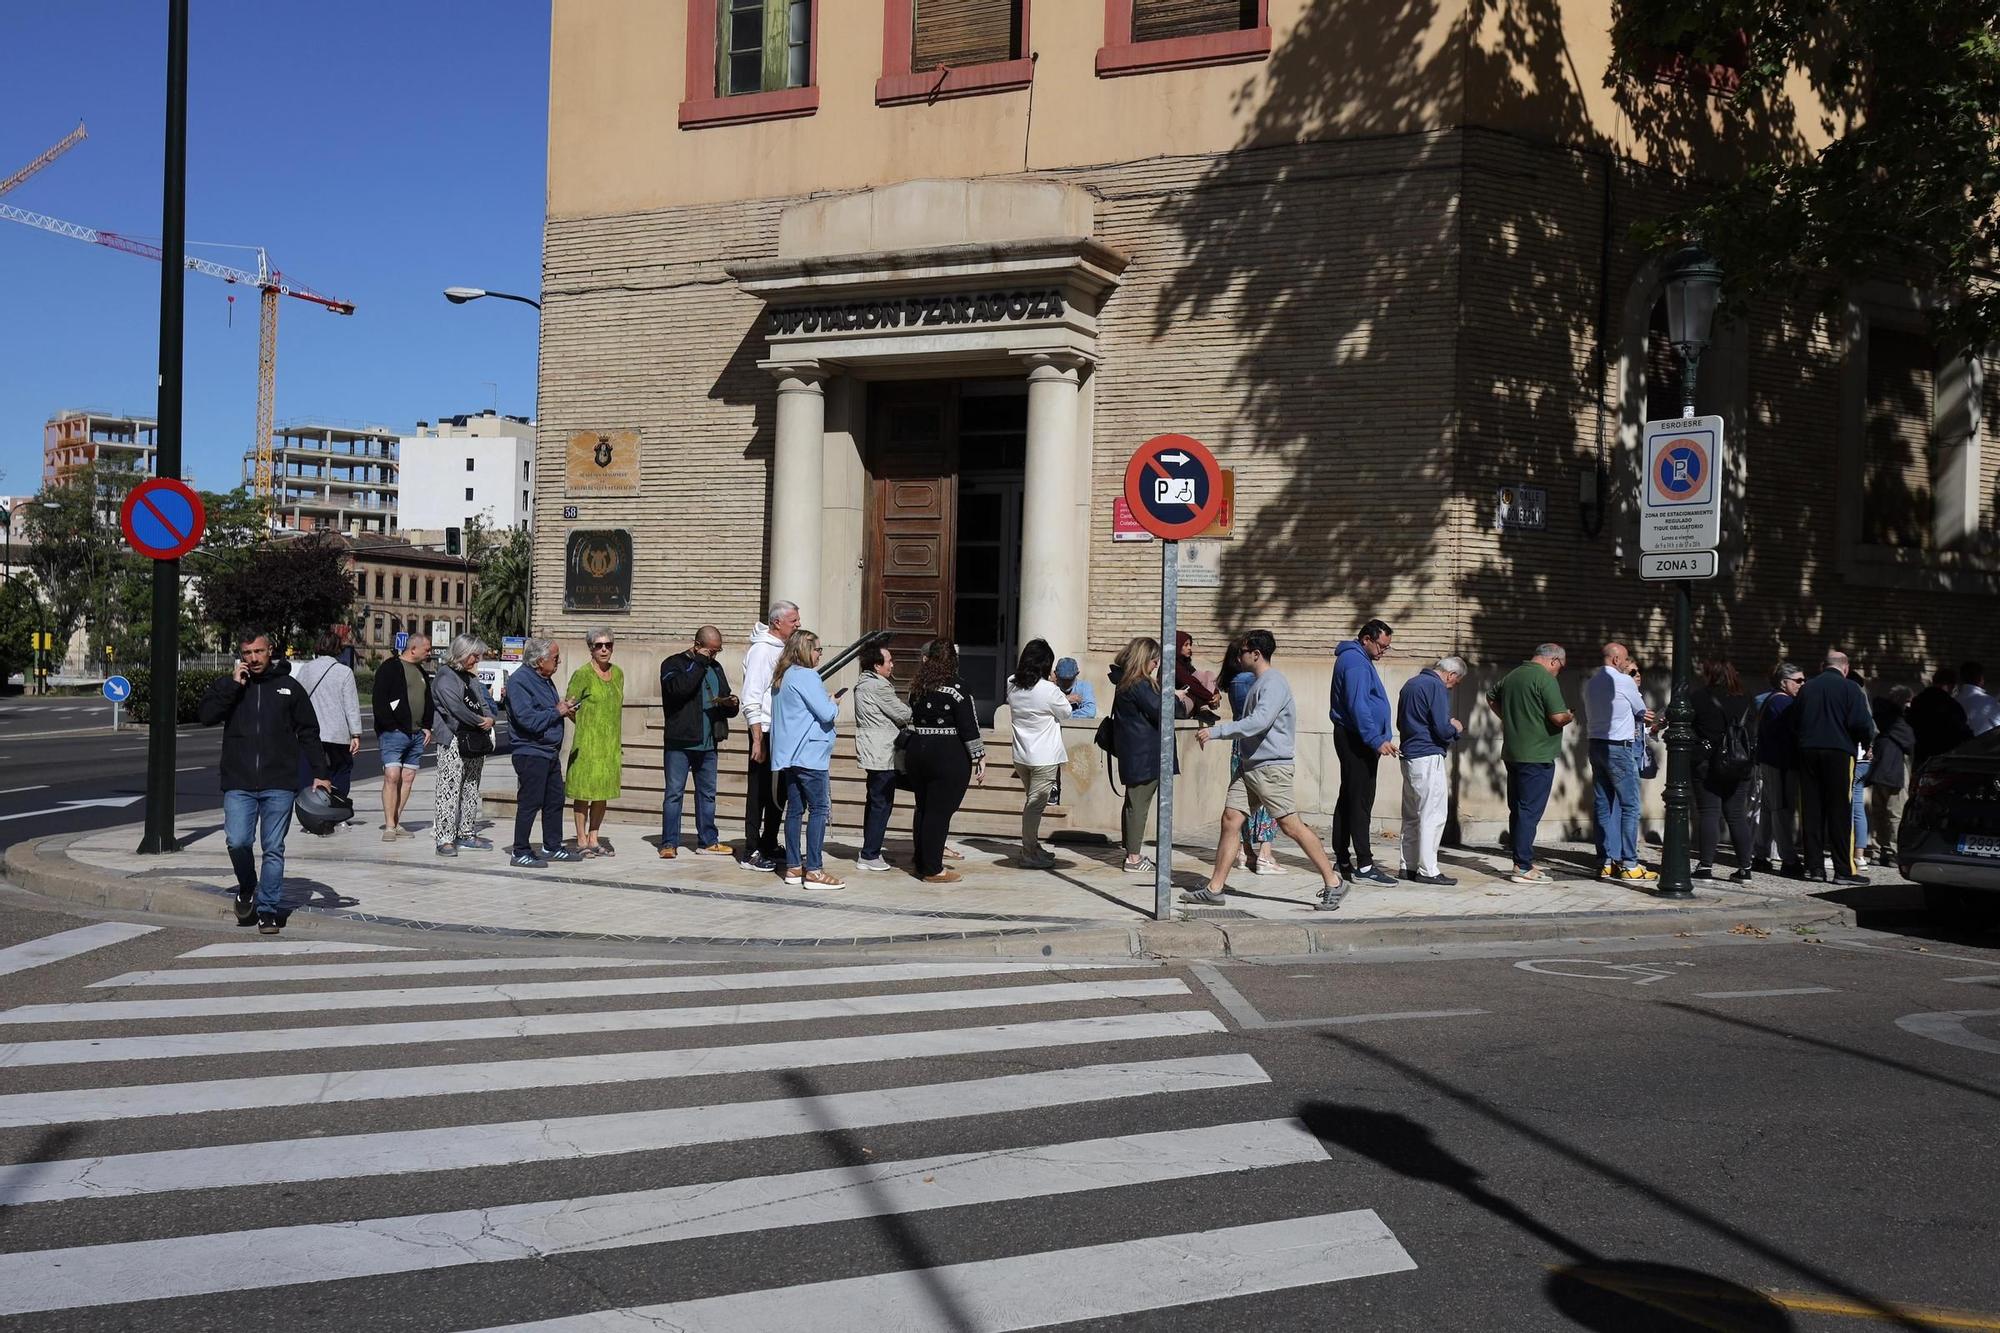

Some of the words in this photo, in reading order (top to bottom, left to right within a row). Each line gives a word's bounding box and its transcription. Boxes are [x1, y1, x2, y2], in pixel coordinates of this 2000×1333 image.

[1675, 461, 1686, 477] P
[1158, 480, 1169, 501] P
[1656, 560, 1688, 571] ZONA
[1691, 559, 1697, 570] 3
